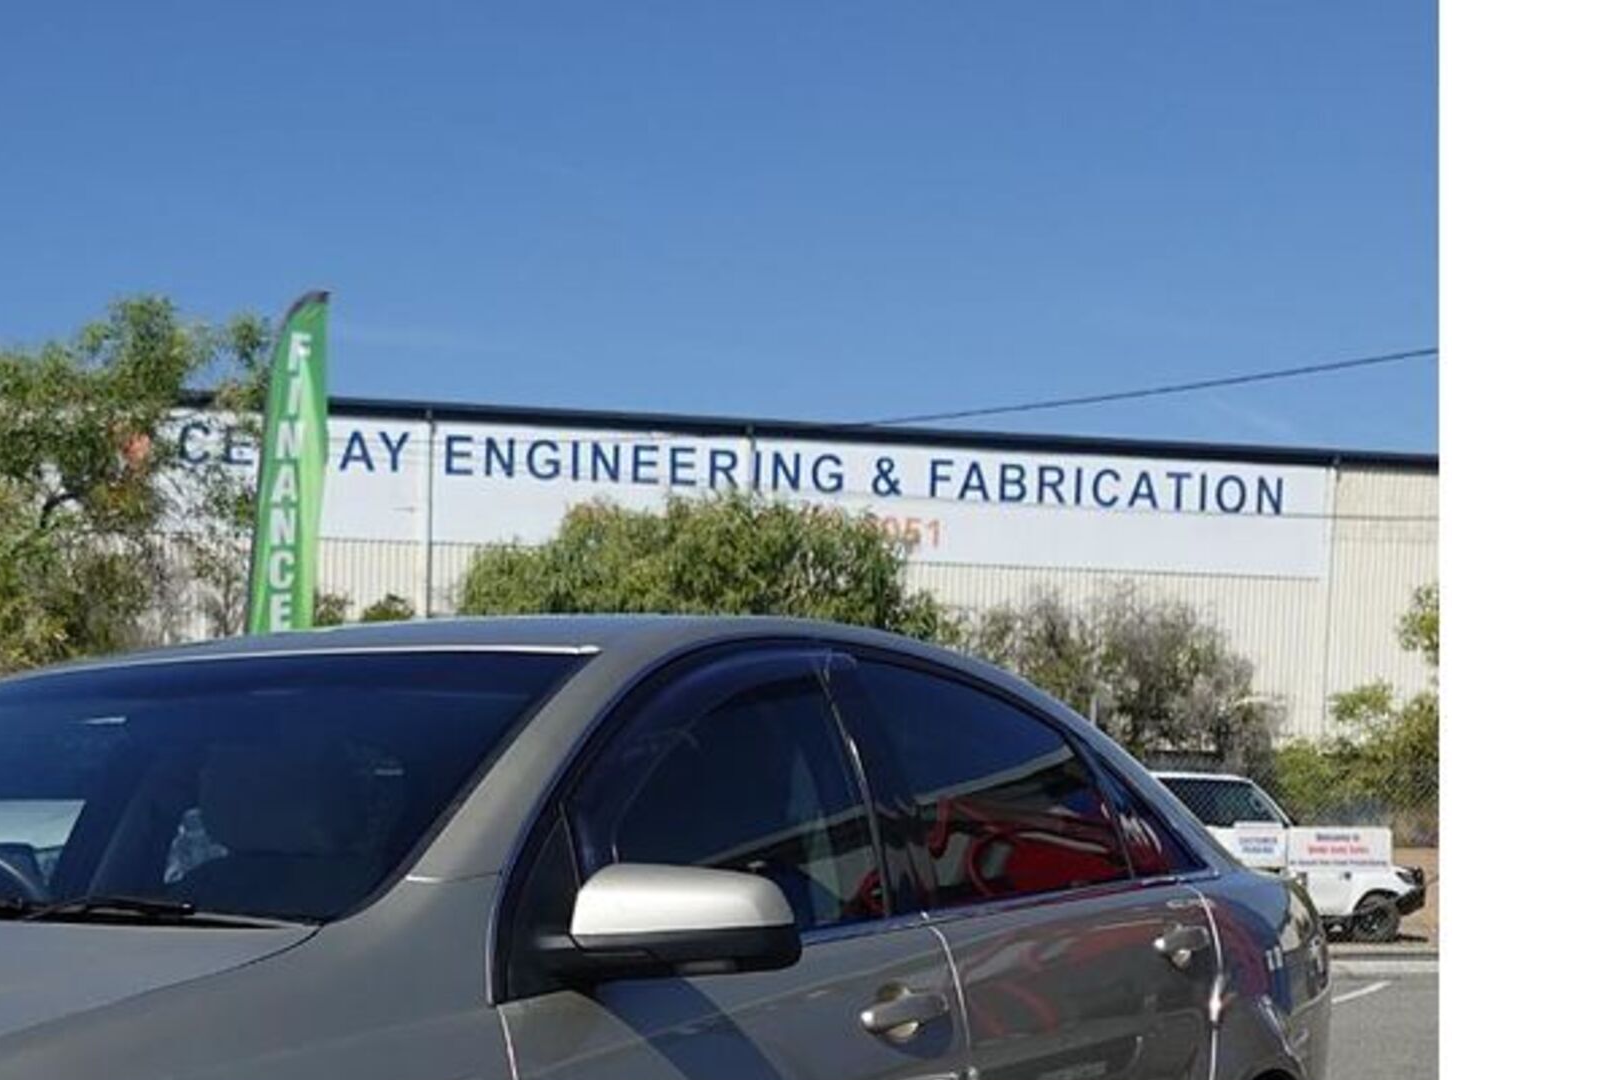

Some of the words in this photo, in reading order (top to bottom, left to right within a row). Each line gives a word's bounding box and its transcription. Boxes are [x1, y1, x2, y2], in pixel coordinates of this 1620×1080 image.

[266, 331, 311, 632] FINANCE
[445, 434, 845, 493] ENGINEERING
[871, 456, 902, 497] &
[930, 459, 1285, 516] FABRICATION
